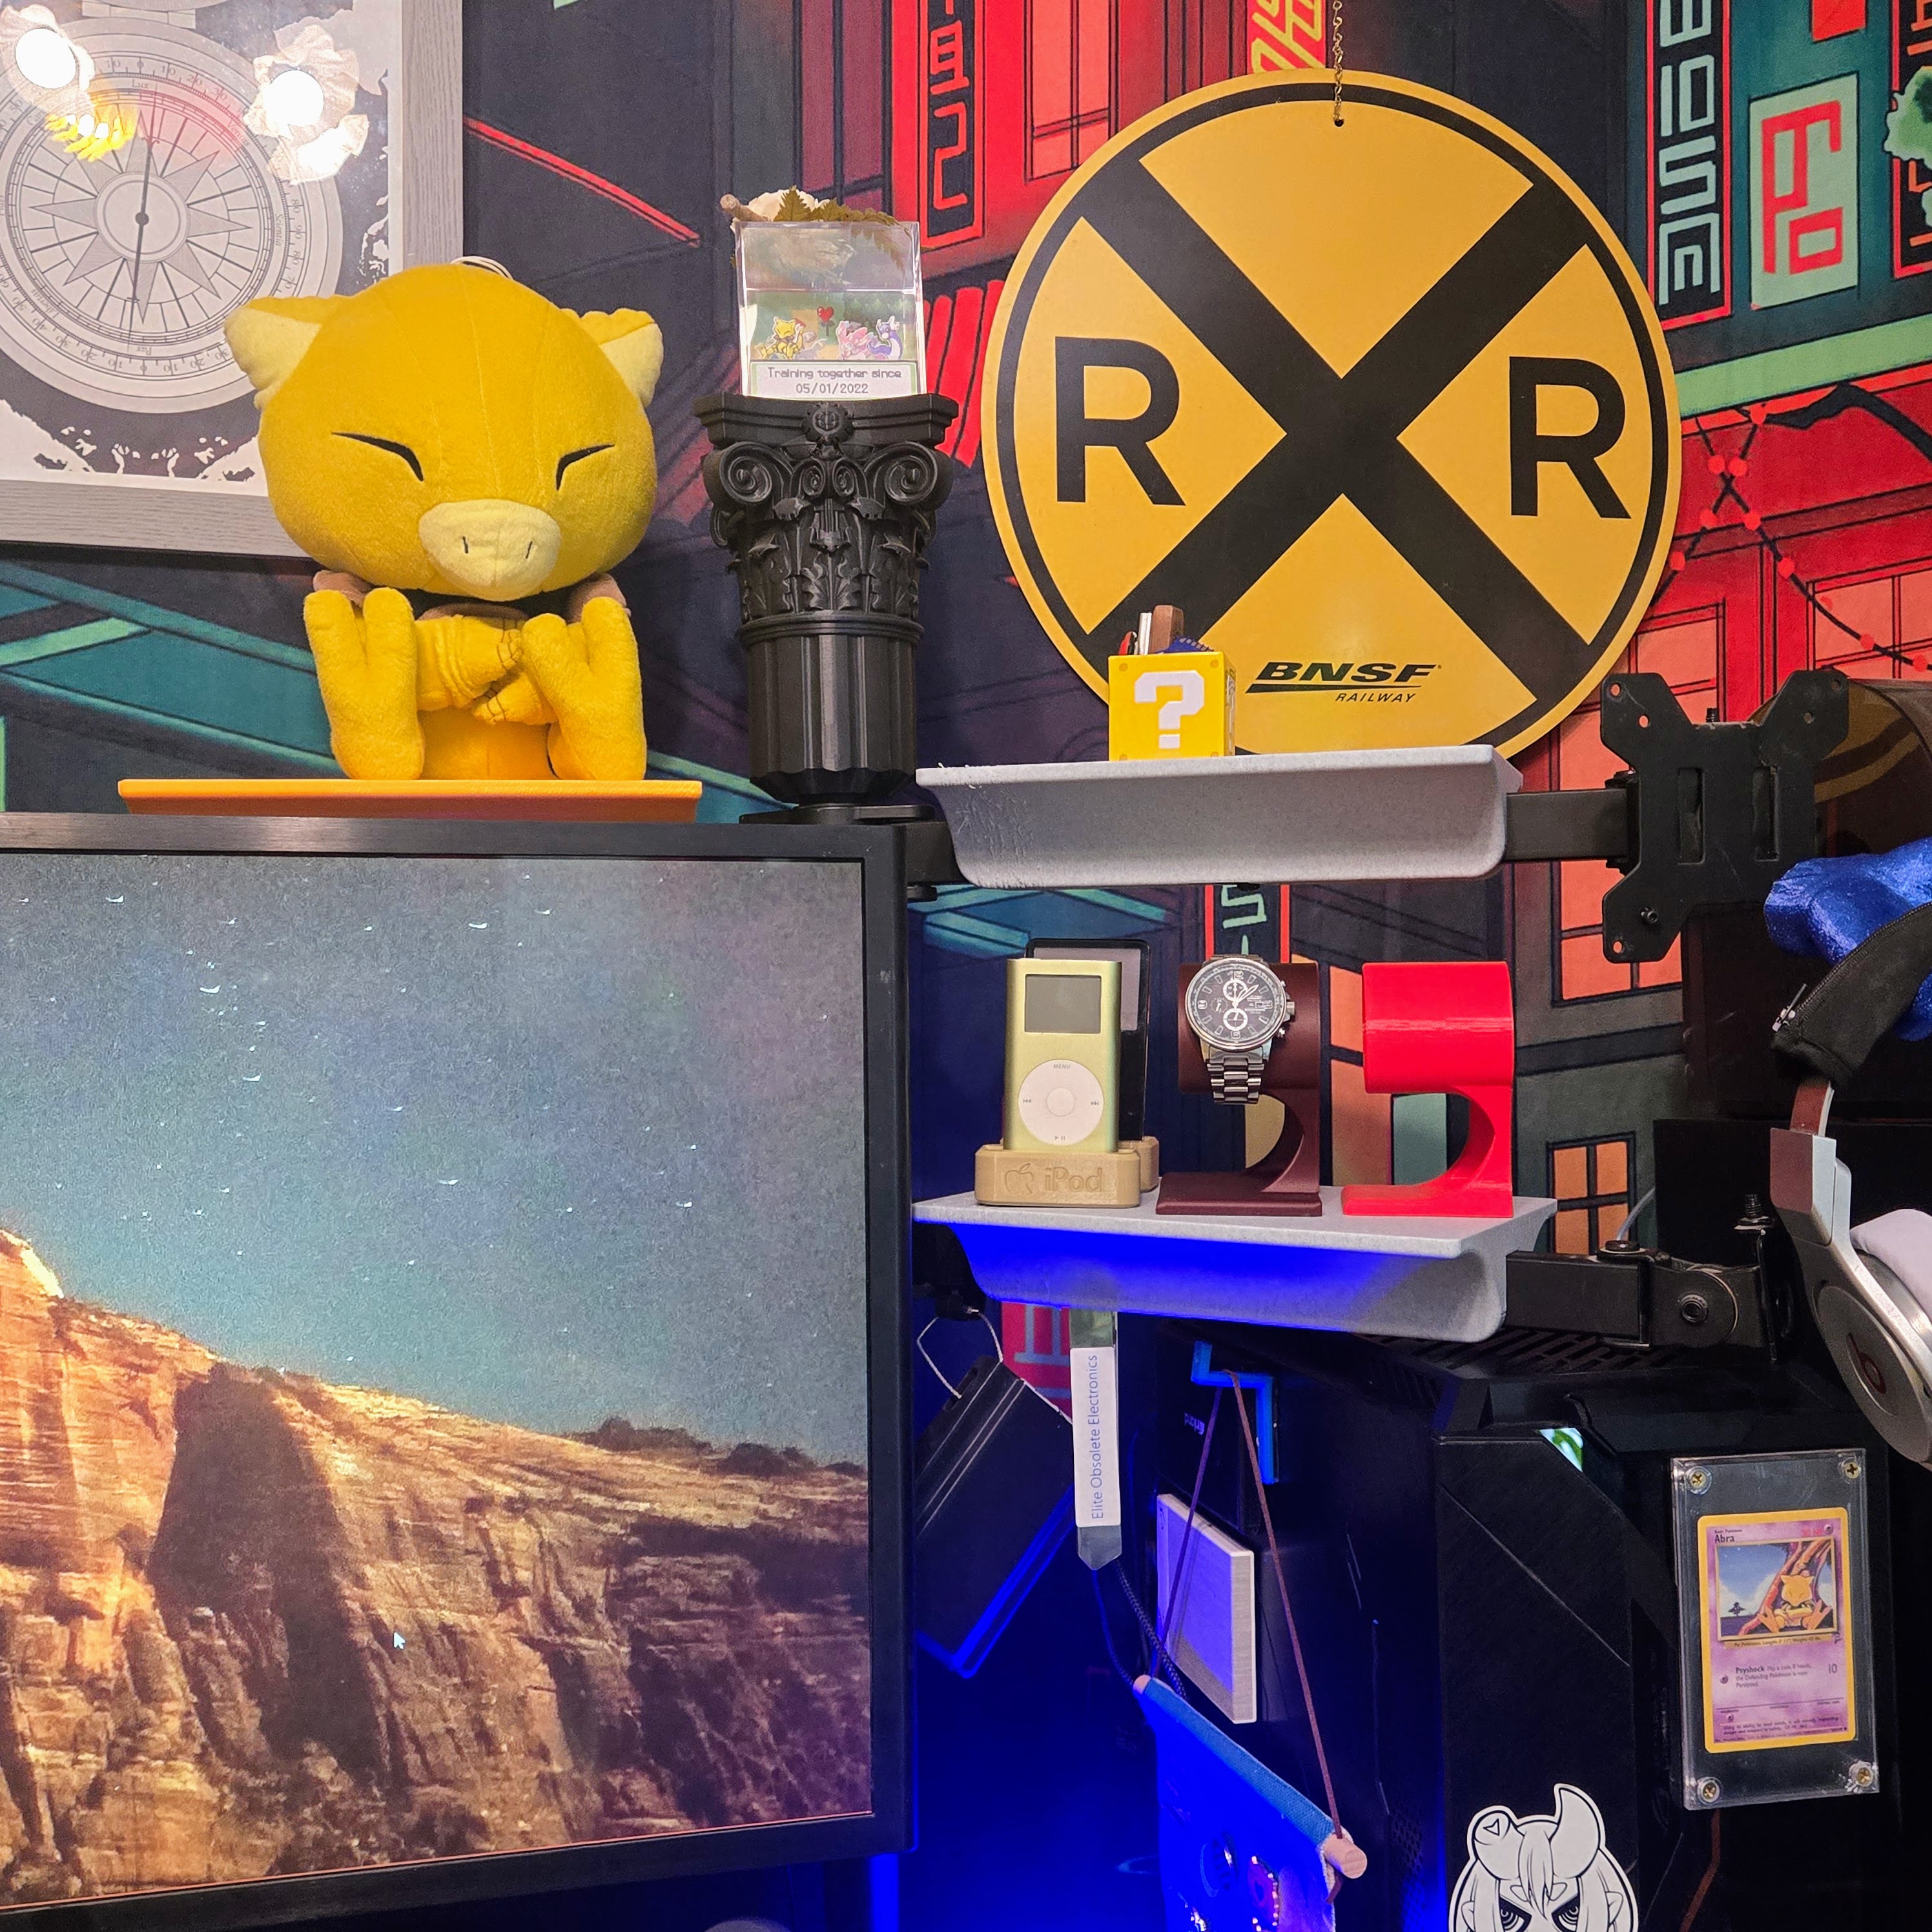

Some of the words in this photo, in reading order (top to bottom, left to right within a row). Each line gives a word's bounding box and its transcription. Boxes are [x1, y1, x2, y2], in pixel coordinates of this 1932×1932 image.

[132, 79, 149, 89] Lux
[275, 213, 283, 247] Scientia
[768, 367, 814, 380] Training
[817, 368, 868, 380] together
[872, 369, 901, 378] since
[796, 382, 868, 395] 05/01/2022
[1054, 336, 1186, 506] R
[1509, 356, 1631, 519] R
[1256, 662, 1437, 683] BNSF
[1335, 693, 1415, 703] RAILWAY
[1044, 1166, 1103, 1193] iPod
[1086, 1355, 1100, 1424] Electronics
[1089, 1428, 1103, 1488] Obsolete
[1091, 1492, 1104, 1519] Elite
[1714, 1534, 1735, 1543] Abra
[1735, 1665, 1764, 1675] Psyshock
[1828, 1663, 1838, 1674] 10
